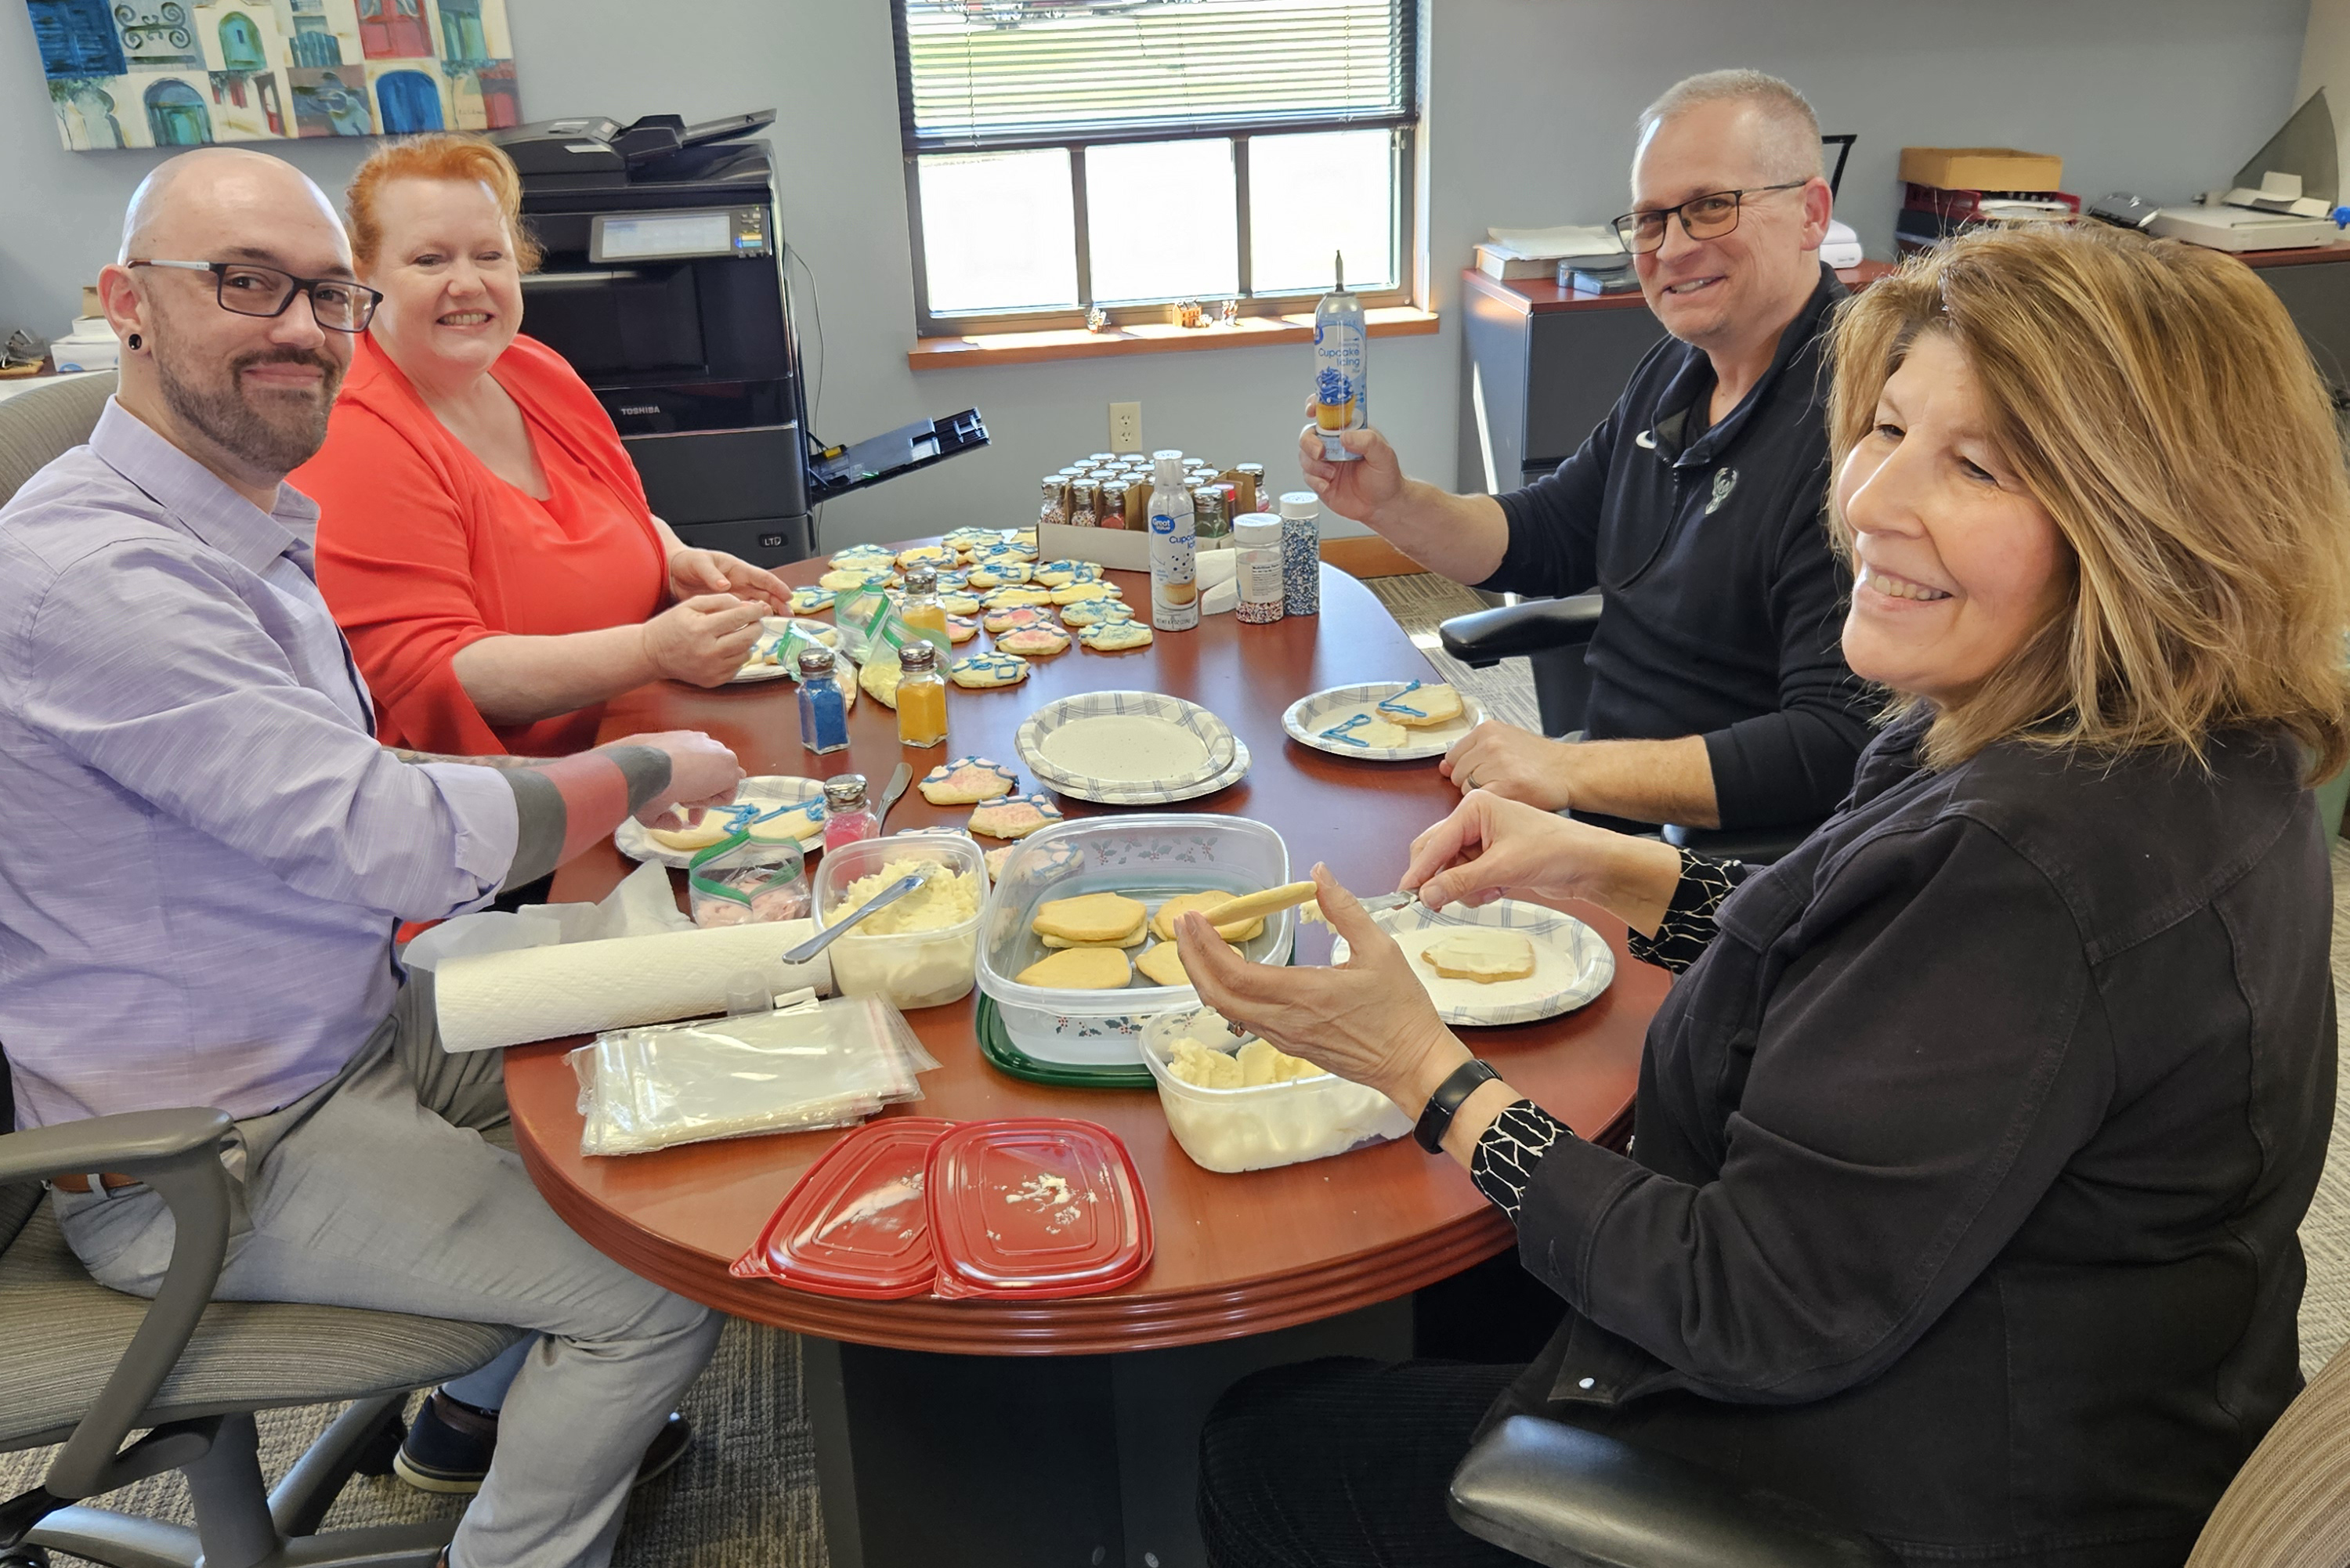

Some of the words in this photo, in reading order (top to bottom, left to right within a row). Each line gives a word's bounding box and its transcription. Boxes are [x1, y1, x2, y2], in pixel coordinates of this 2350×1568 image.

[1318, 347, 1360, 359] Cupcake
[1336, 357, 1361, 368] Icing
[620, 406, 660, 416] TOSHIBA
[1152, 517, 1170, 527] Great
